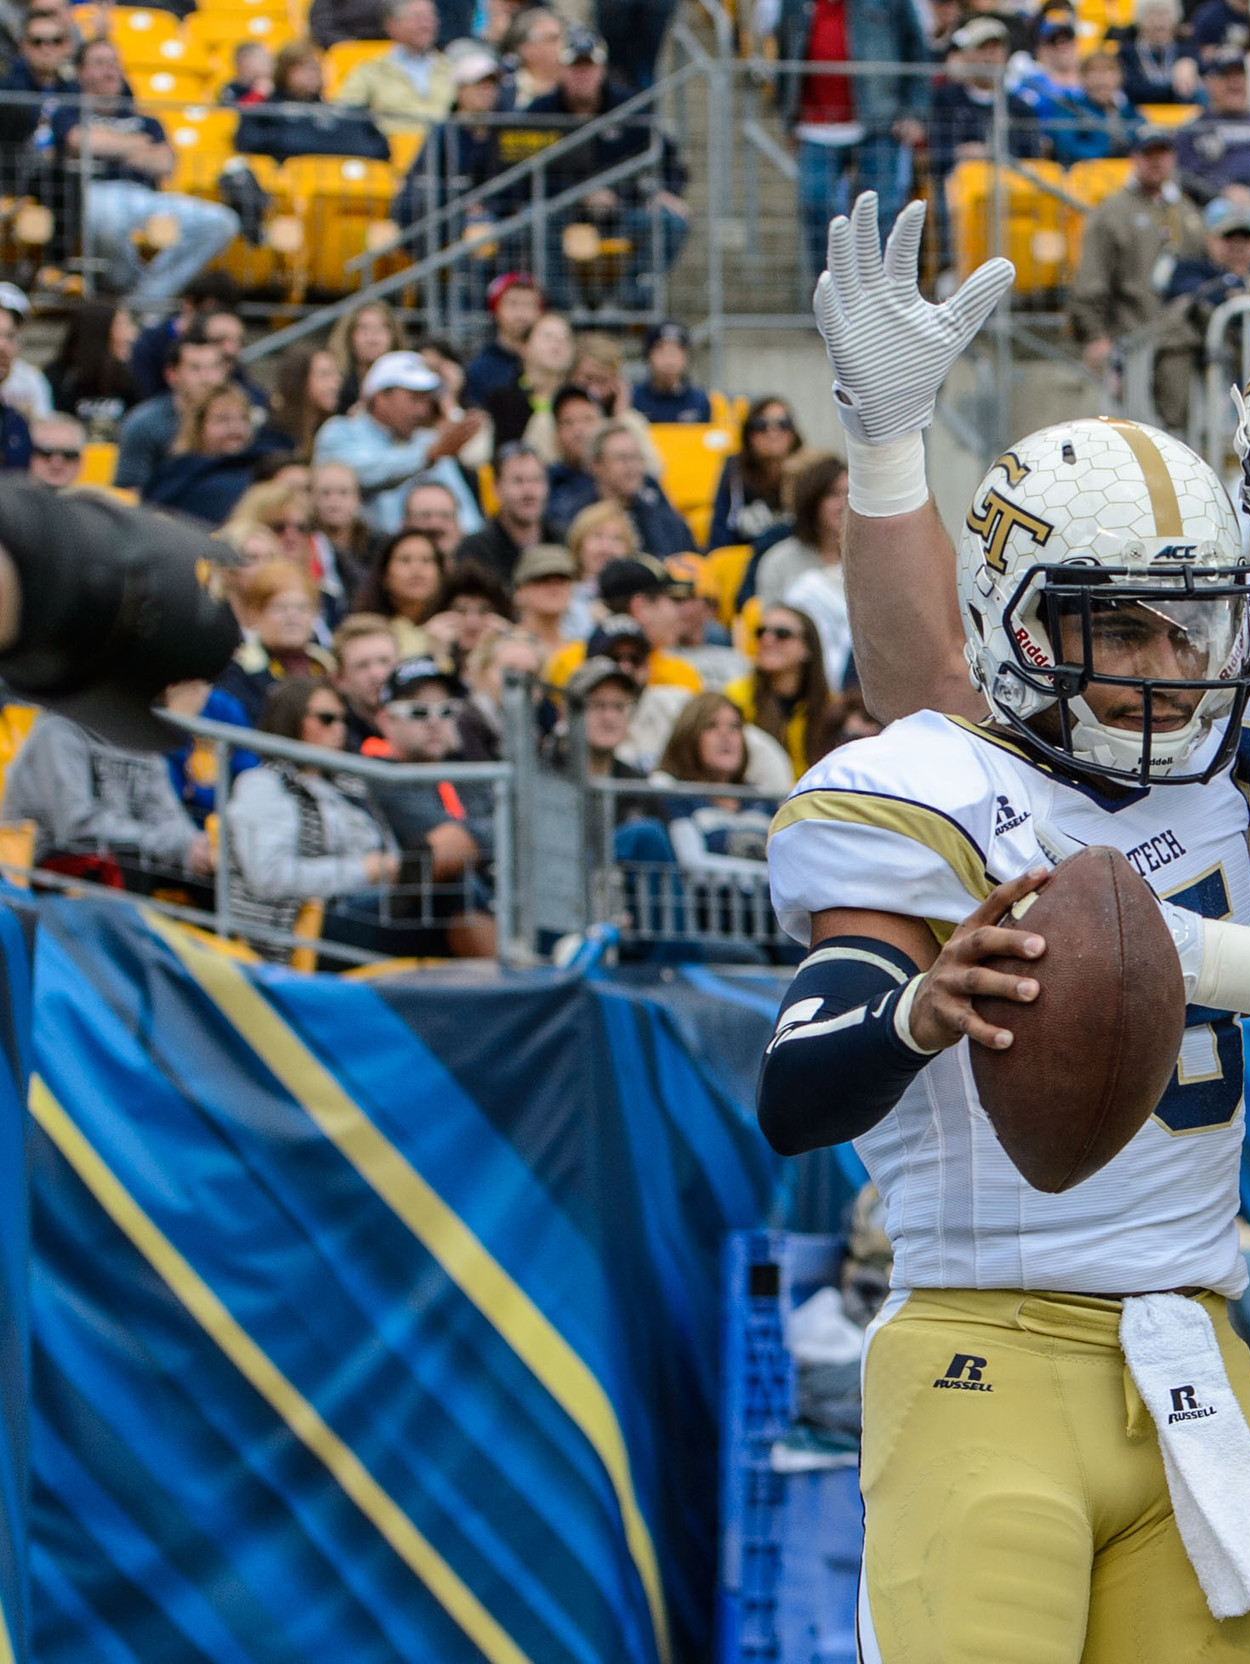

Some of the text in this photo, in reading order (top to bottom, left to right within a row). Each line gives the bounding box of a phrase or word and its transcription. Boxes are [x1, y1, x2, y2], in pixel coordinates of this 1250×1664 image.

[1154, 545, 1198, 559] ACC
[1127, 829, 1187, 878] TECH
[944, 1352, 987, 1381] R
[933, 1379, 994, 1392] RUSSELL
[1169, 1384, 1198, 1412] R
[1168, 1406, 1217, 1425] RUSSELL
